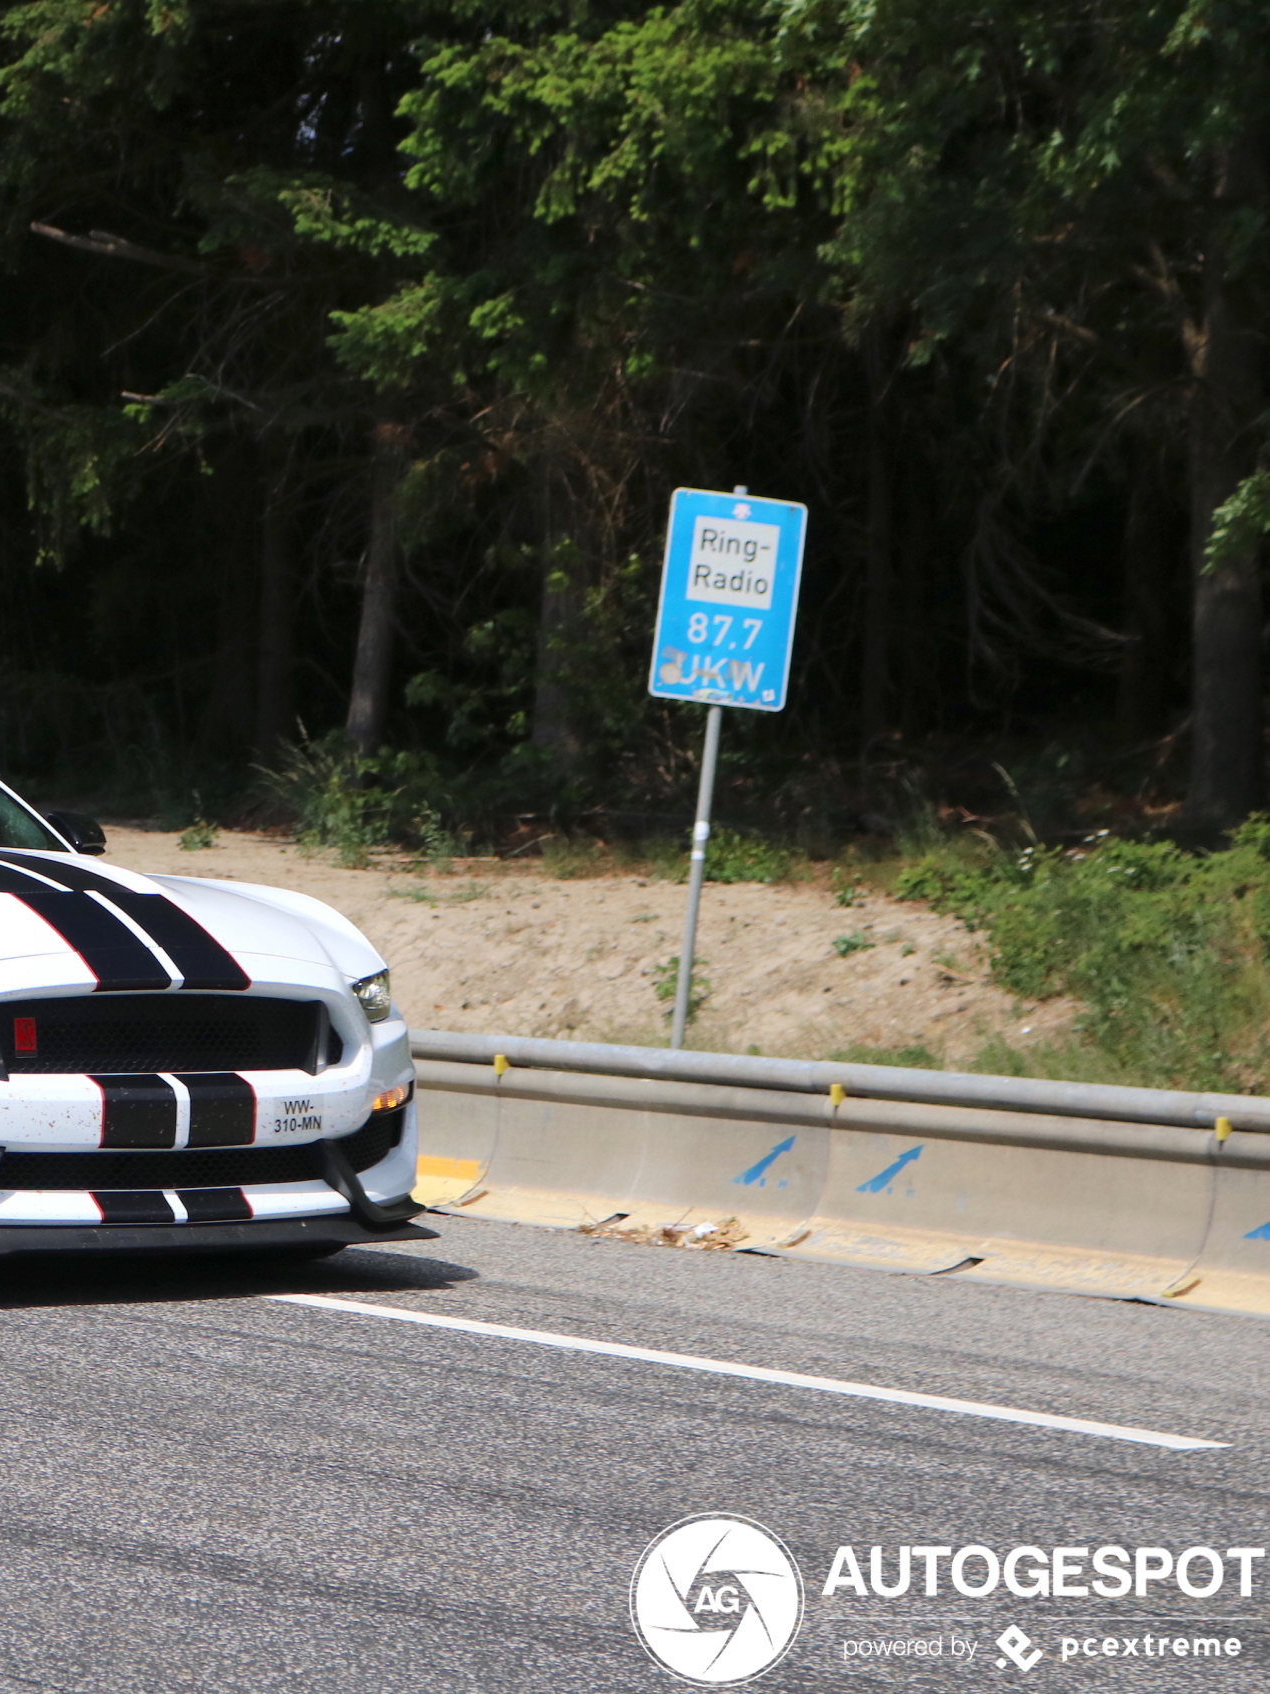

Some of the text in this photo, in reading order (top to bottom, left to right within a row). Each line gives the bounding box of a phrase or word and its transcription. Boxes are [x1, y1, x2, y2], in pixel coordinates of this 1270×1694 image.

[700, 529, 771, 563] Ring-
[694, 564, 768, 595] Radio
[676, 653, 766, 692] UKW
[284, 1099, 314, 1115] WW-
[274, 1116, 322, 1133] 310-MN
